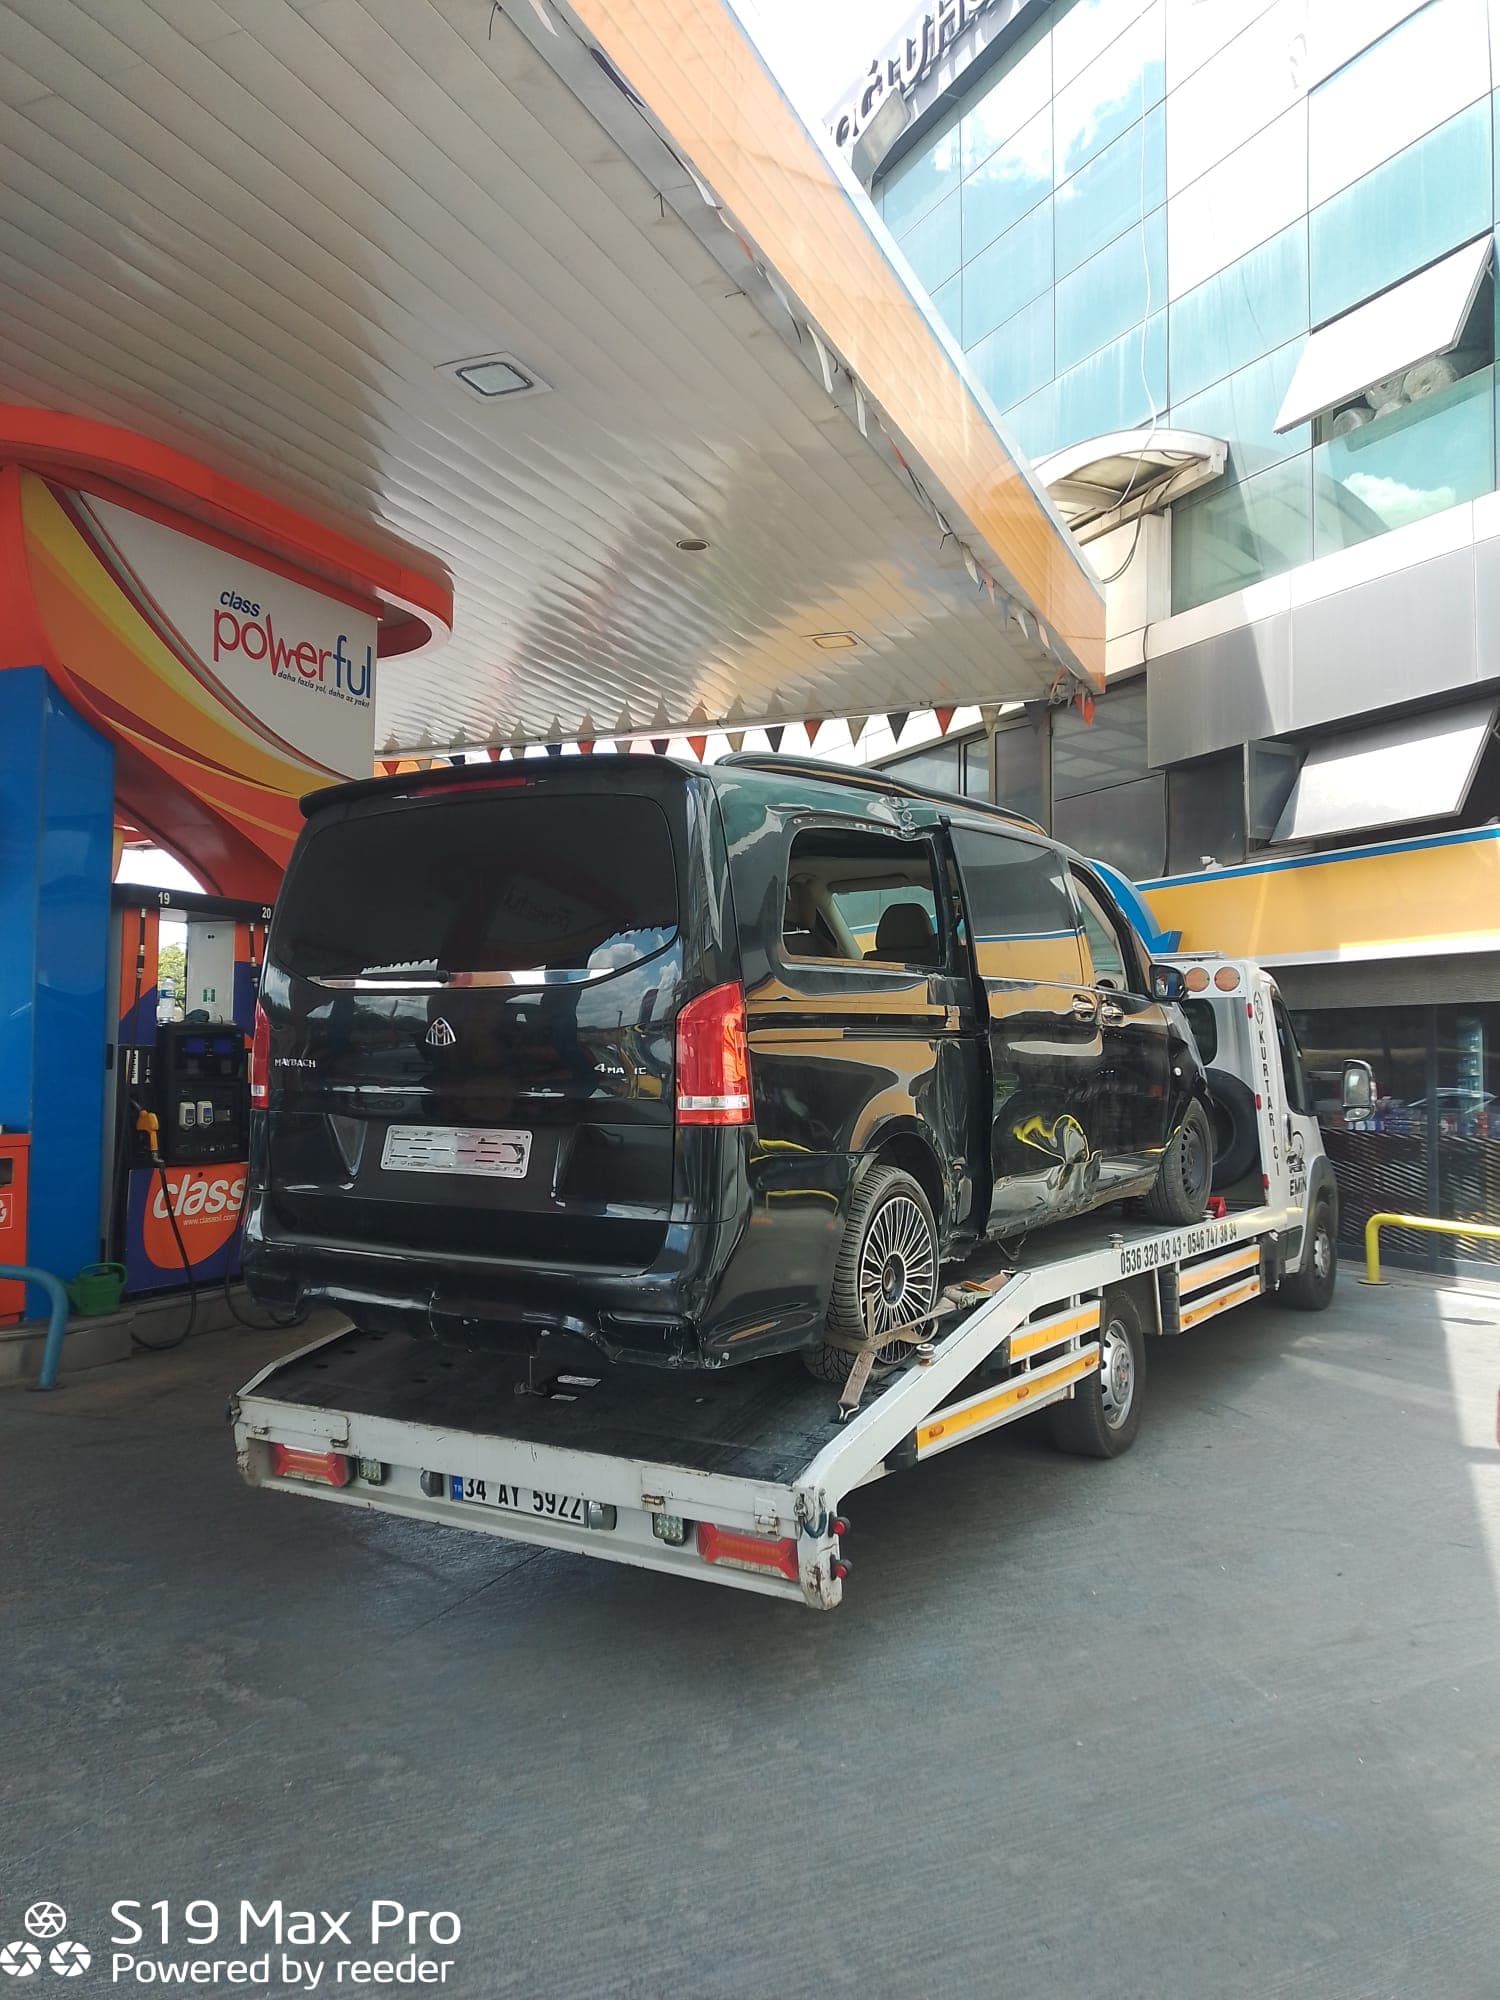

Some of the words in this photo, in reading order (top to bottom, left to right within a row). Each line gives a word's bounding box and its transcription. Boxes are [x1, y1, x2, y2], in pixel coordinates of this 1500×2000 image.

[220, 591, 261, 617] class
[213, 609, 372, 698] powerful
[278, 670, 296, 683] daha
[329, 688, 344, 700] daha
[158, 891, 170, 905] 19
[262, 906, 271, 919] 20
[274, 1057, 316, 1068] MAYBACH
[1258, 1029, 1281, 1177] KURTARICI
[153, 1173, 246, 1219] class
[1120, 1247, 1142, 1275] 0536
[1144, 1242, 1159, 1268] 328
[1161, 1239, 1171, 1263] 43
[1172, 1236, 1182, 1259] 43
[1206, 1224, 1219, 1249] 747
[465, 1479, 487, 1501] 34
[498, 1484, 519, 1507] AY
